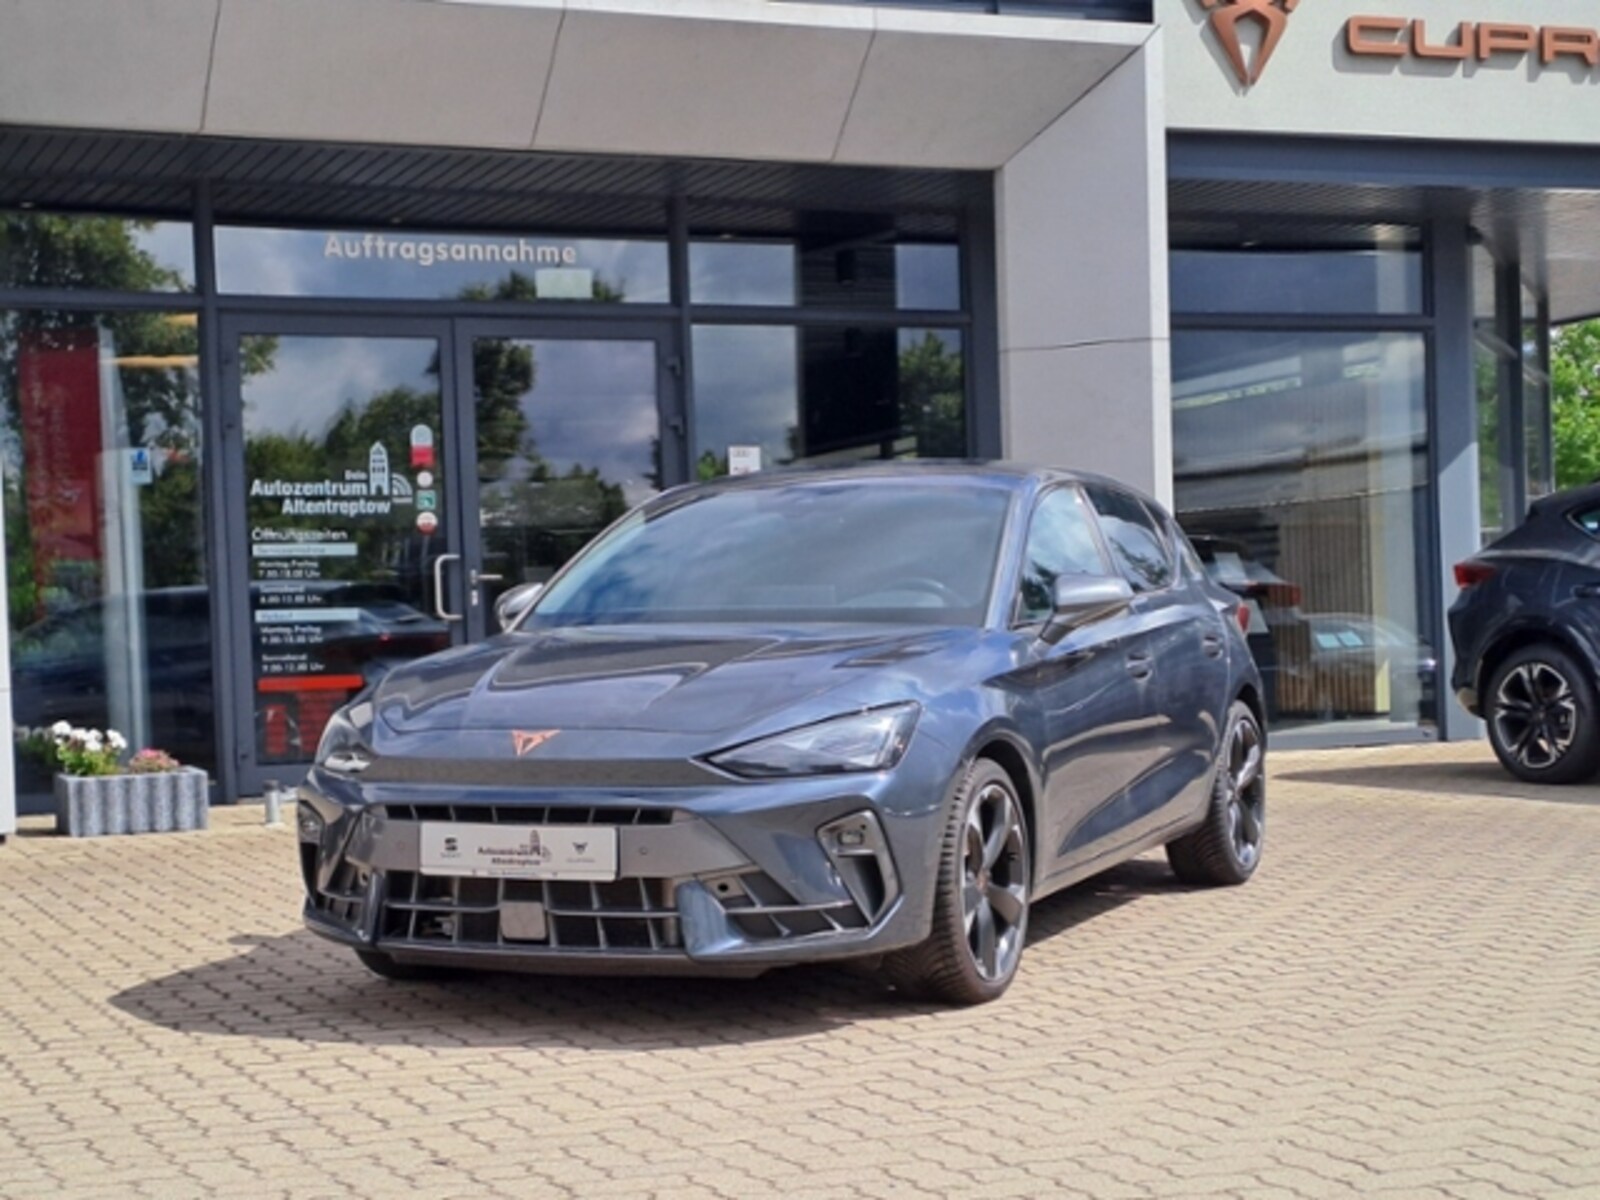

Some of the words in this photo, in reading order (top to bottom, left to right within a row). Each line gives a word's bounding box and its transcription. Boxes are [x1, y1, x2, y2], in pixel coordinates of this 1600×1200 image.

[1346, 15, 1600, 66] CUPR
[324, 233, 577, 266] Auftragsannahme
[250, 479, 368, 496] Autozentrum
[282, 498, 391, 517] Altentreptow
